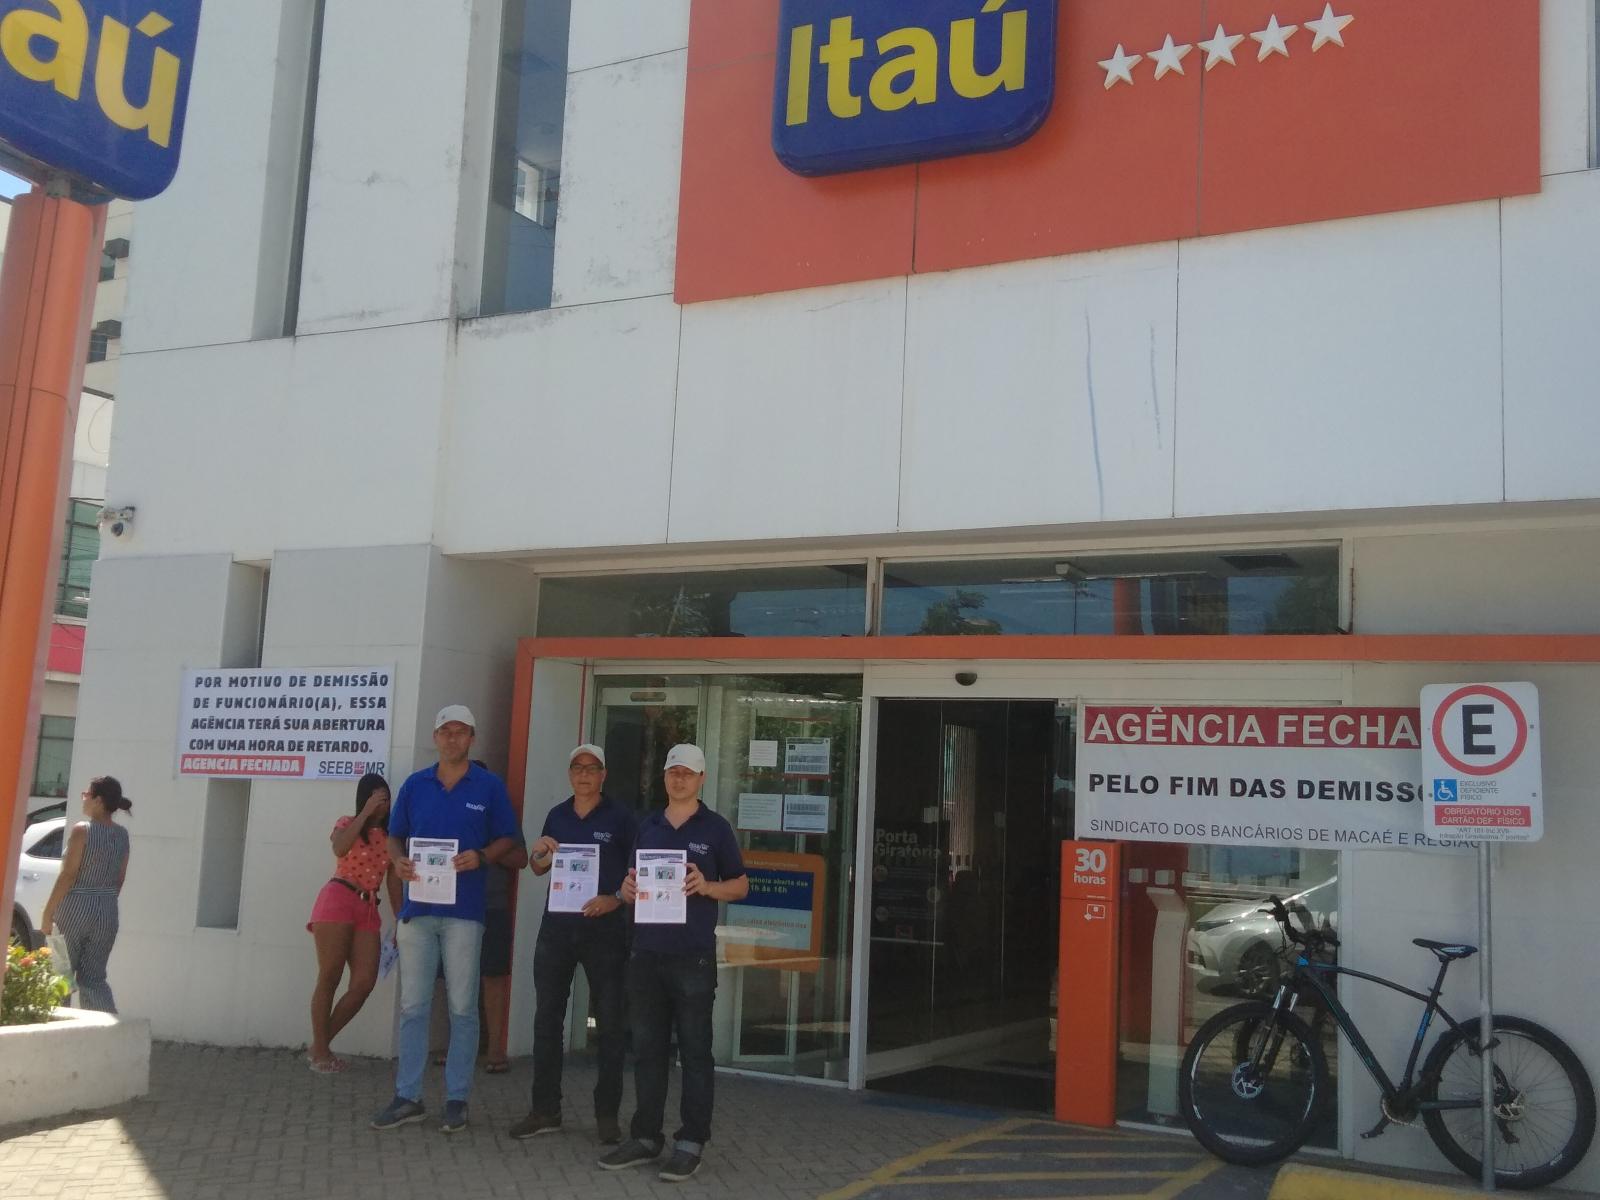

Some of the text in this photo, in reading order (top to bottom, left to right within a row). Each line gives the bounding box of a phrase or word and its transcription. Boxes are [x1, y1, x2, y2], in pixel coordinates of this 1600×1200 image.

[785, 0, 1029, 126] Itaú
[194, 672, 389, 688] POR MOTIVO DE DEMISSÃO
[193, 695, 387, 711] DE FUNCIONÁRIO(A), ESSA
[190, 716, 385, 731] AGÊNCIA TERÁ SUA ABERTURA
[1088, 706, 1265, 744] AGÊNCIA
[1462, 704, 1497, 755] E
[189, 738, 373, 753] COM UMA HORA DE RETARDO.
[240, 758, 300, 772] FECHADA
[1089, 773, 1159, 794] PELO
[1170, 776, 1218, 797] FIM
[1230, 778, 1286, 799] DAS
[1503, 808, 1522, 816] USO
[875, 828, 918, 844] Porta
[1090, 819, 1169, 835] SINDICATO
[1174, 823, 1206, 836] DOS
[1211, 823, 1303, 841] BANCÁRIOS
[1308, 829, 1329, 842] DE
[1335, 828, 1393, 844] MACAÉ
[1399, 831, 1409, 845] E
[1074, 848, 1107, 873] 30
[1073, 872, 1106, 885] horas
